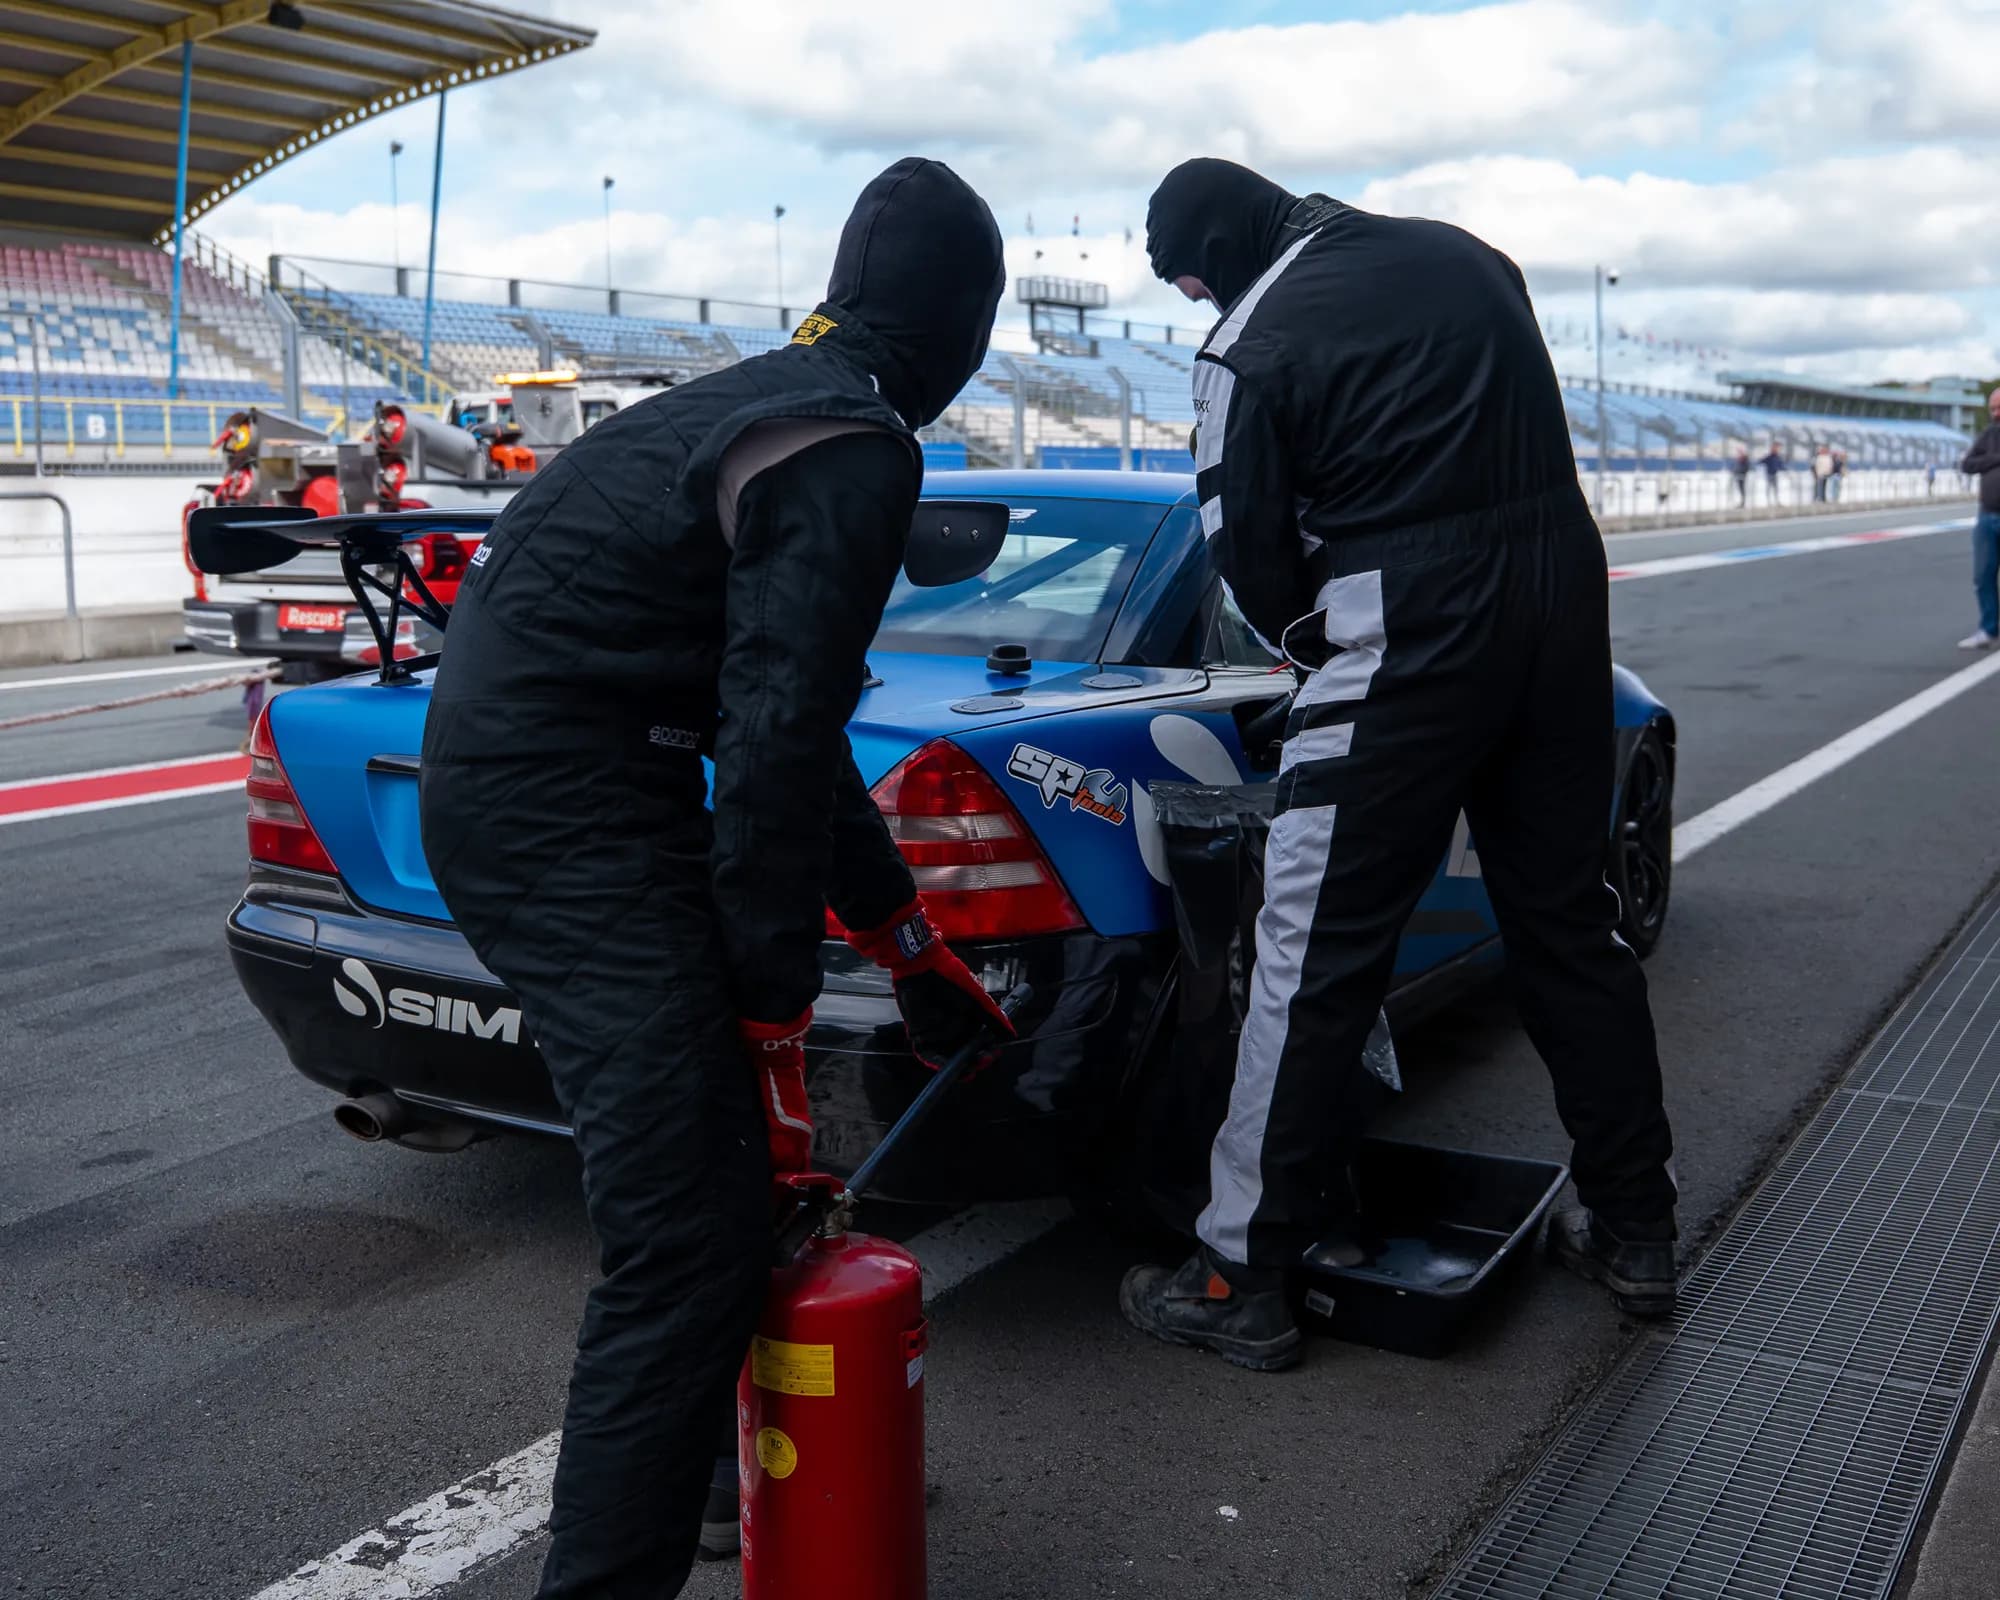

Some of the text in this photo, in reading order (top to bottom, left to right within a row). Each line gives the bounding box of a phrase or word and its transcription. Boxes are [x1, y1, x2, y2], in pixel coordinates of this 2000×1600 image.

[289, 606, 336, 627] Rescue
[1009, 745, 1086, 805] SP
[1071, 787, 1125, 823] tools
